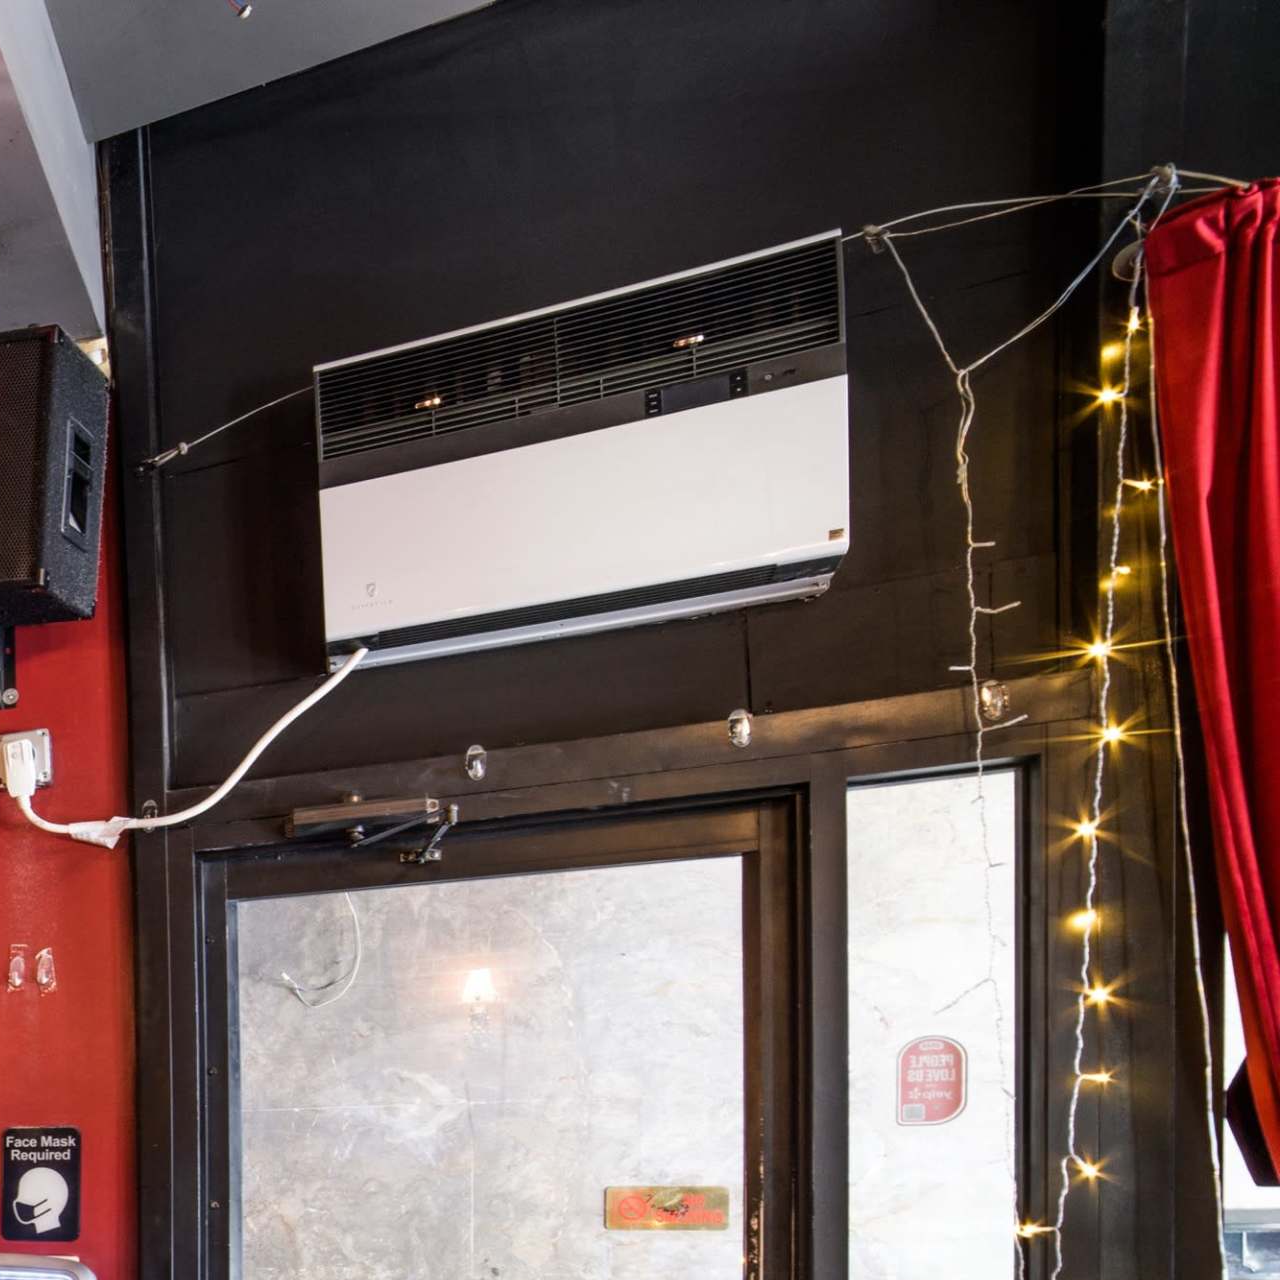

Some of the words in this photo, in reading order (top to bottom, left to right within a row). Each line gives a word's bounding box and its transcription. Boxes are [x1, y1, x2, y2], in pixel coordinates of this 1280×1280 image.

[5, 1136, 37, 1148] Face
[40, 1135, 76, 1148] Mask
[11, 1149, 71, 1163] Required
